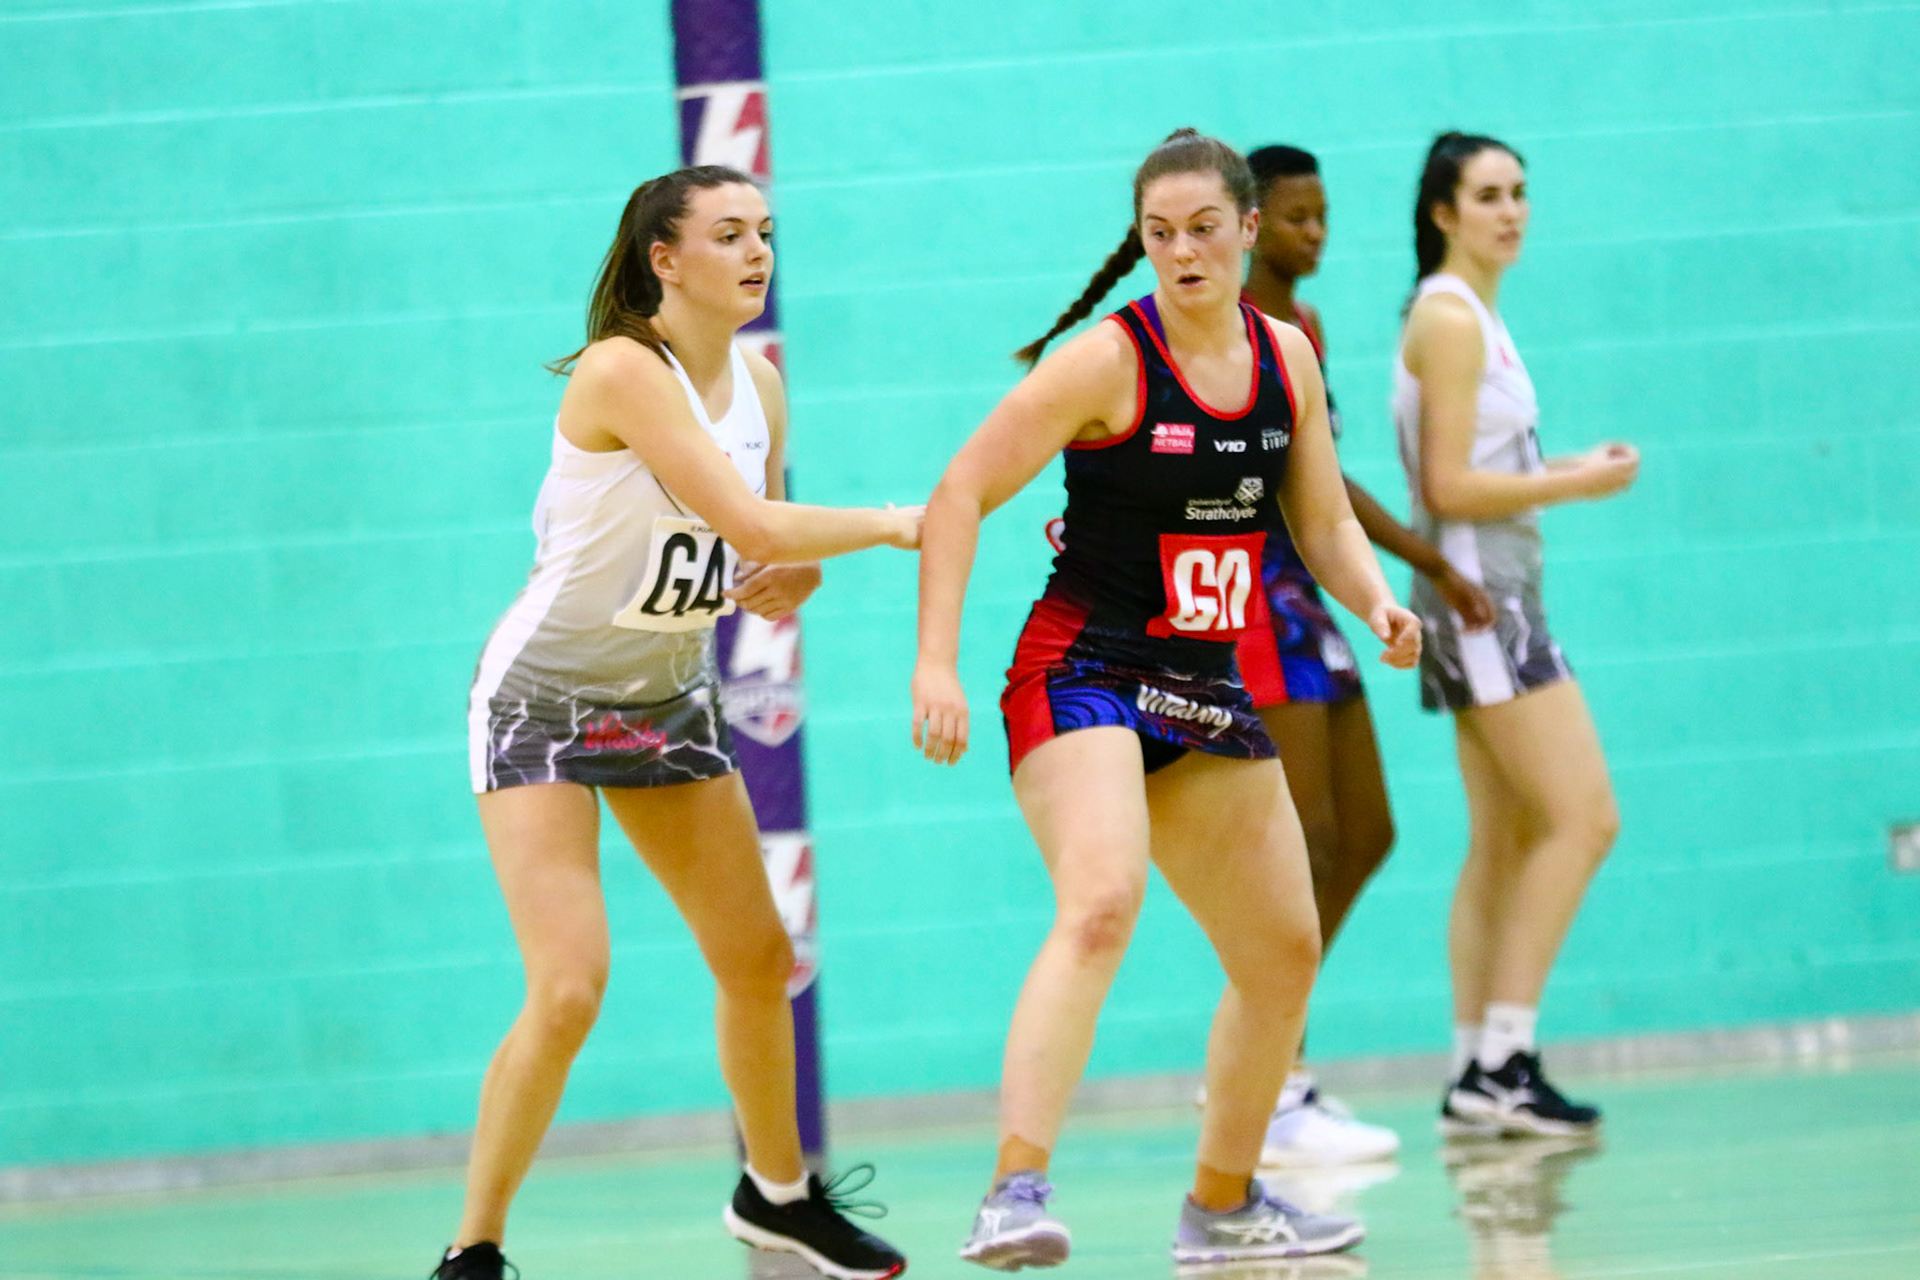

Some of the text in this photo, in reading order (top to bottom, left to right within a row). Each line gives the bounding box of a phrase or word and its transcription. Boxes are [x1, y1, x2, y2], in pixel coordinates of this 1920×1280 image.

[1153, 438, 1193, 448] NETBALL
[1185, 506, 1257, 522] Strathclyde
[640, 532, 725, 617] GA
